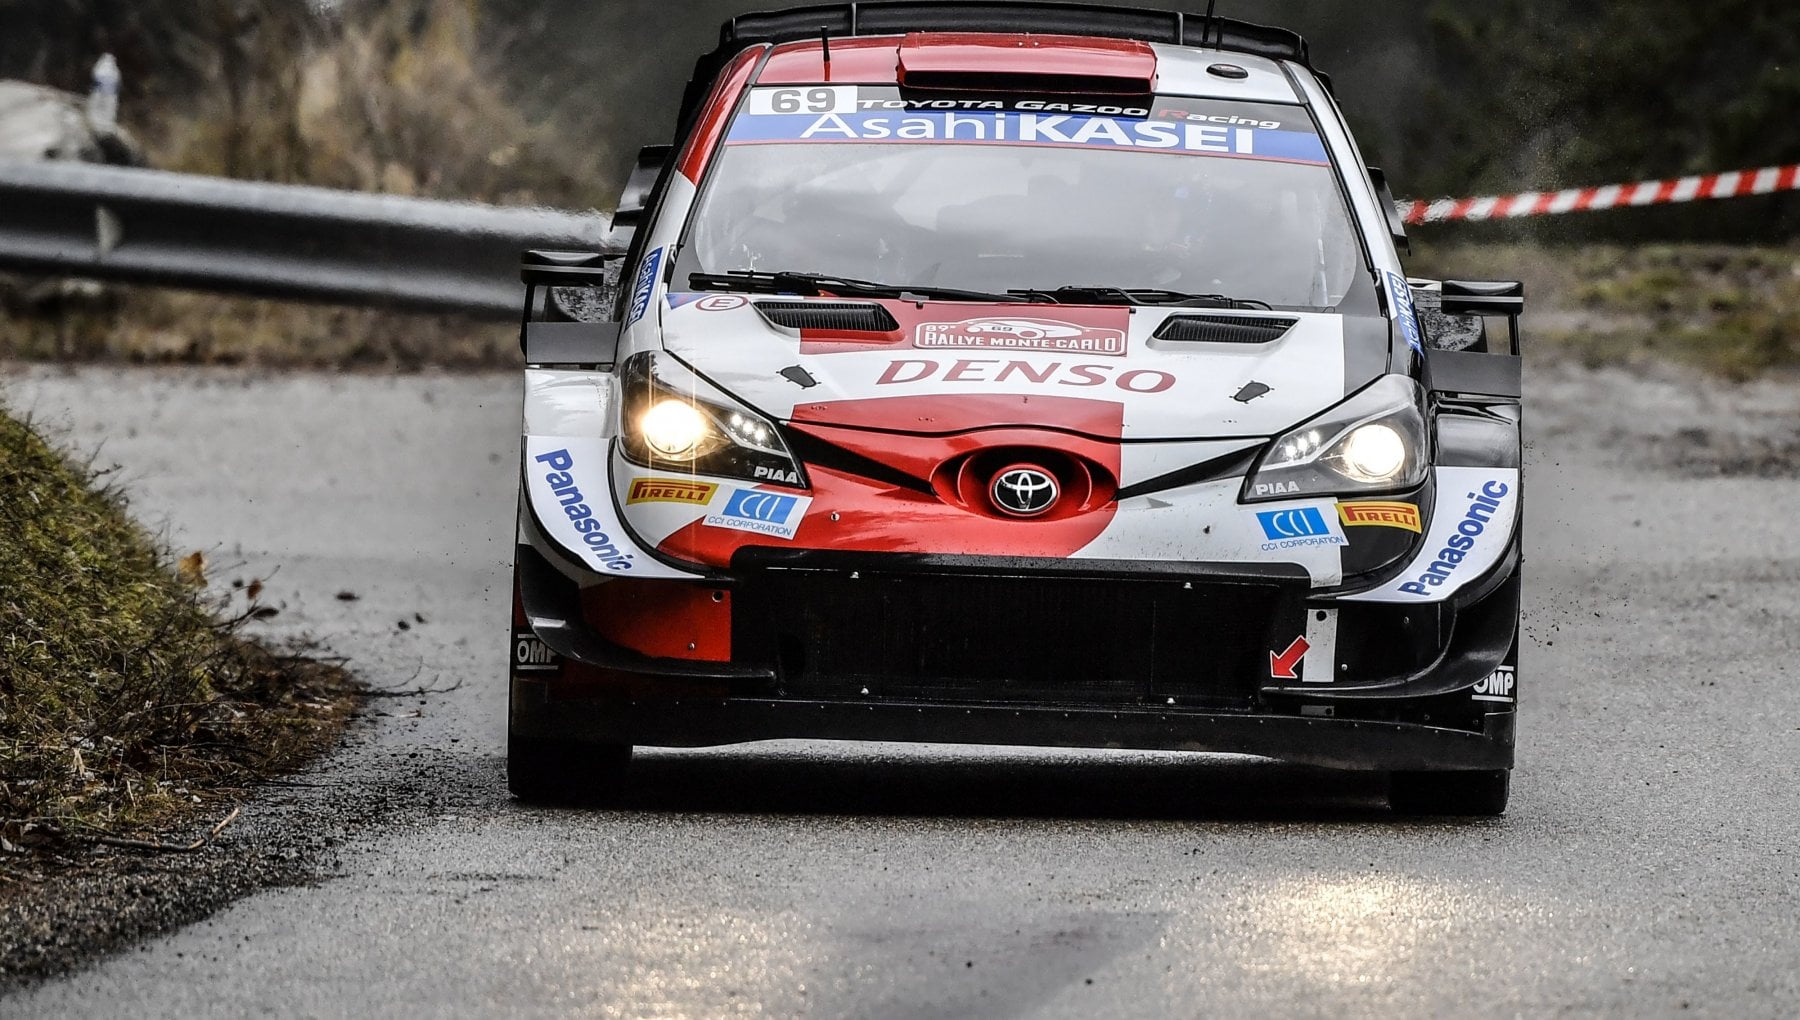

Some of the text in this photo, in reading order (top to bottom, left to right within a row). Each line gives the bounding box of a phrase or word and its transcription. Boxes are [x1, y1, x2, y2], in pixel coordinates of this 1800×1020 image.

[771, 88, 836, 113] 69
[857, 99, 1281, 130] TOYOTA GAZOO Racing
[925, 331, 1116, 352] RALLYE MONTE-CARLO
[876, 359, 1176, 394] DENSO
[754, 466, 798, 484] PIAA
[632, 482, 711, 501] PIRELLI
[1255, 481, 1300, 495] PIAA
[535, 449, 632, 571] Panasonic
[1343, 505, 1416, 527] PIRELLI
[708, 516, 792, 536] CCI CORPORATION
[1261, 536, 1345, 551] CCI CORPORATION
[1397, 480, 1509, 596] Panasonic
